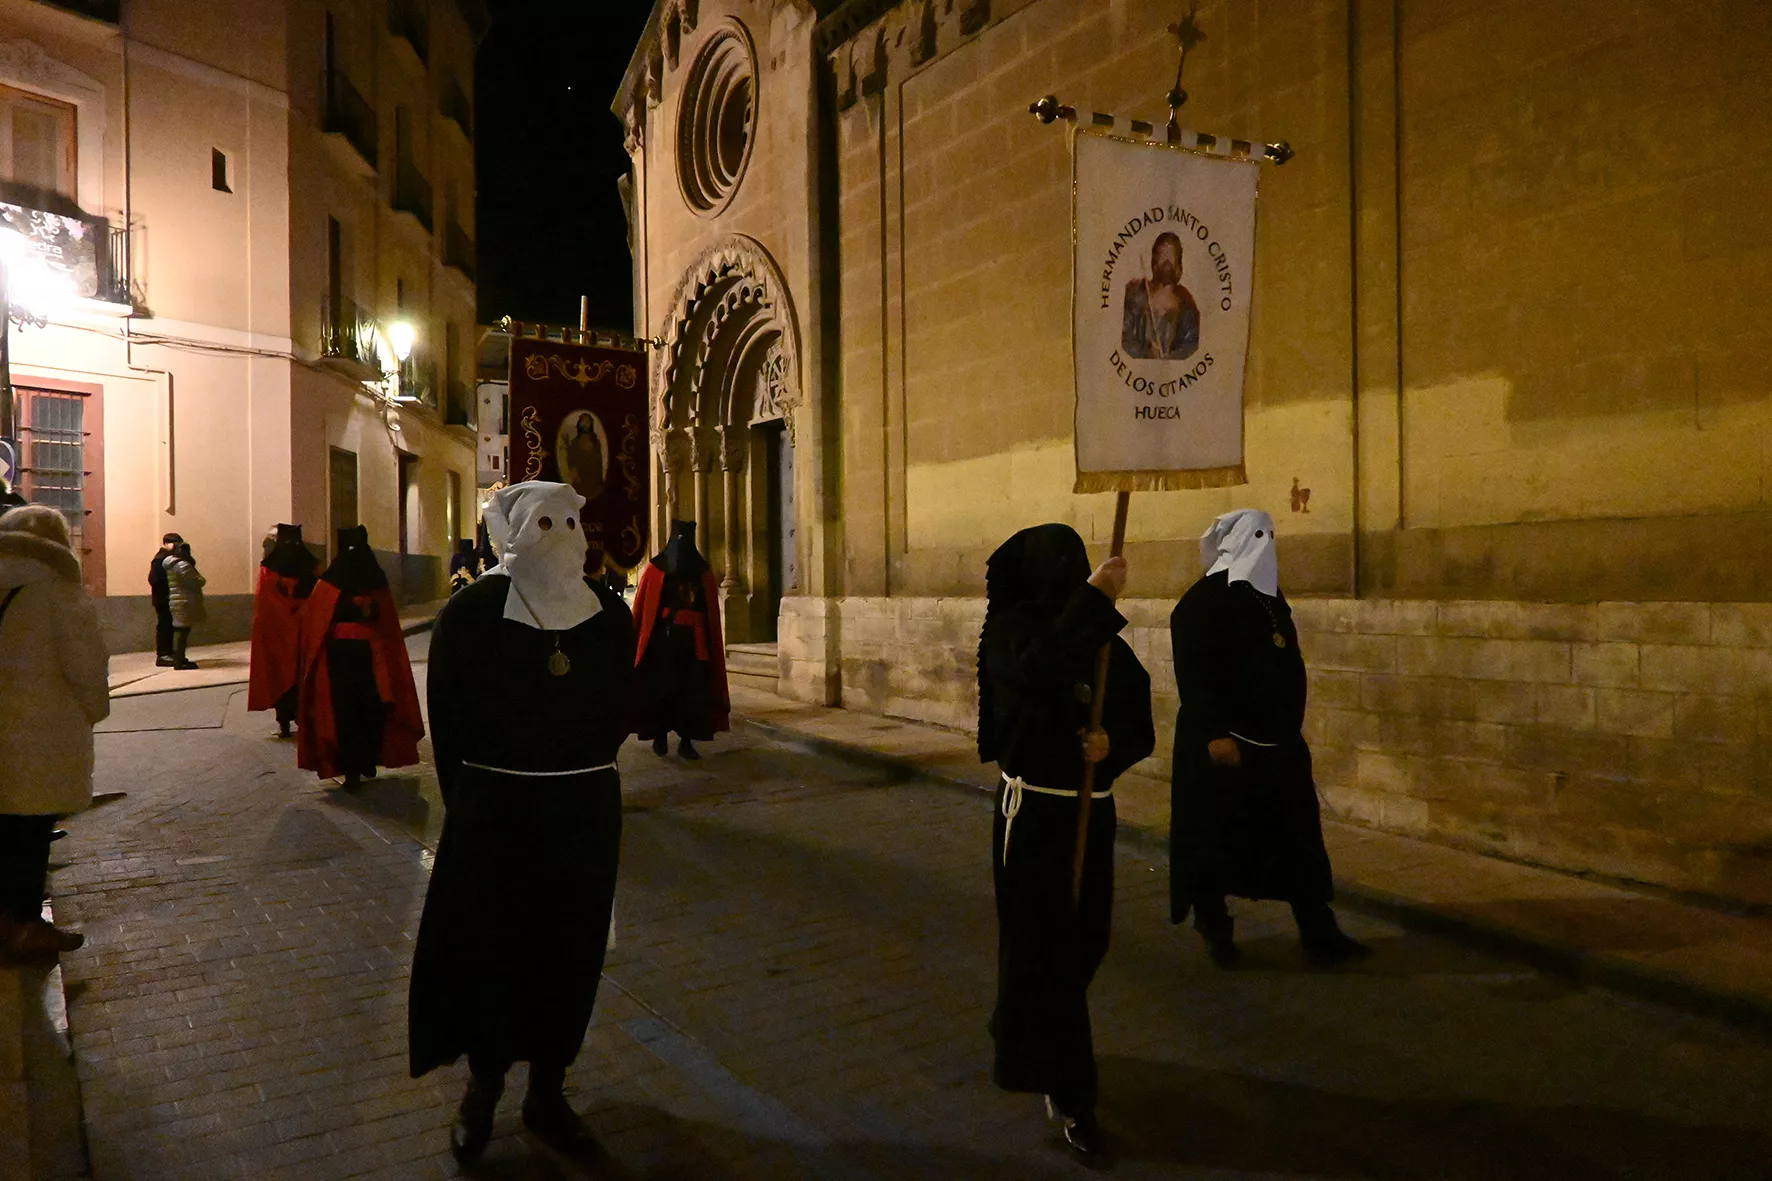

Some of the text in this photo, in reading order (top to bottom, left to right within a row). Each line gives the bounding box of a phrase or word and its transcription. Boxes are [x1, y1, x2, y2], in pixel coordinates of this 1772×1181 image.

[1101, 205, 1232, 311] HERMANDAD SANTO CRISTO
[1109, 350, 1126, 377] DE
[1125, 371, 1155, 396] LOS
